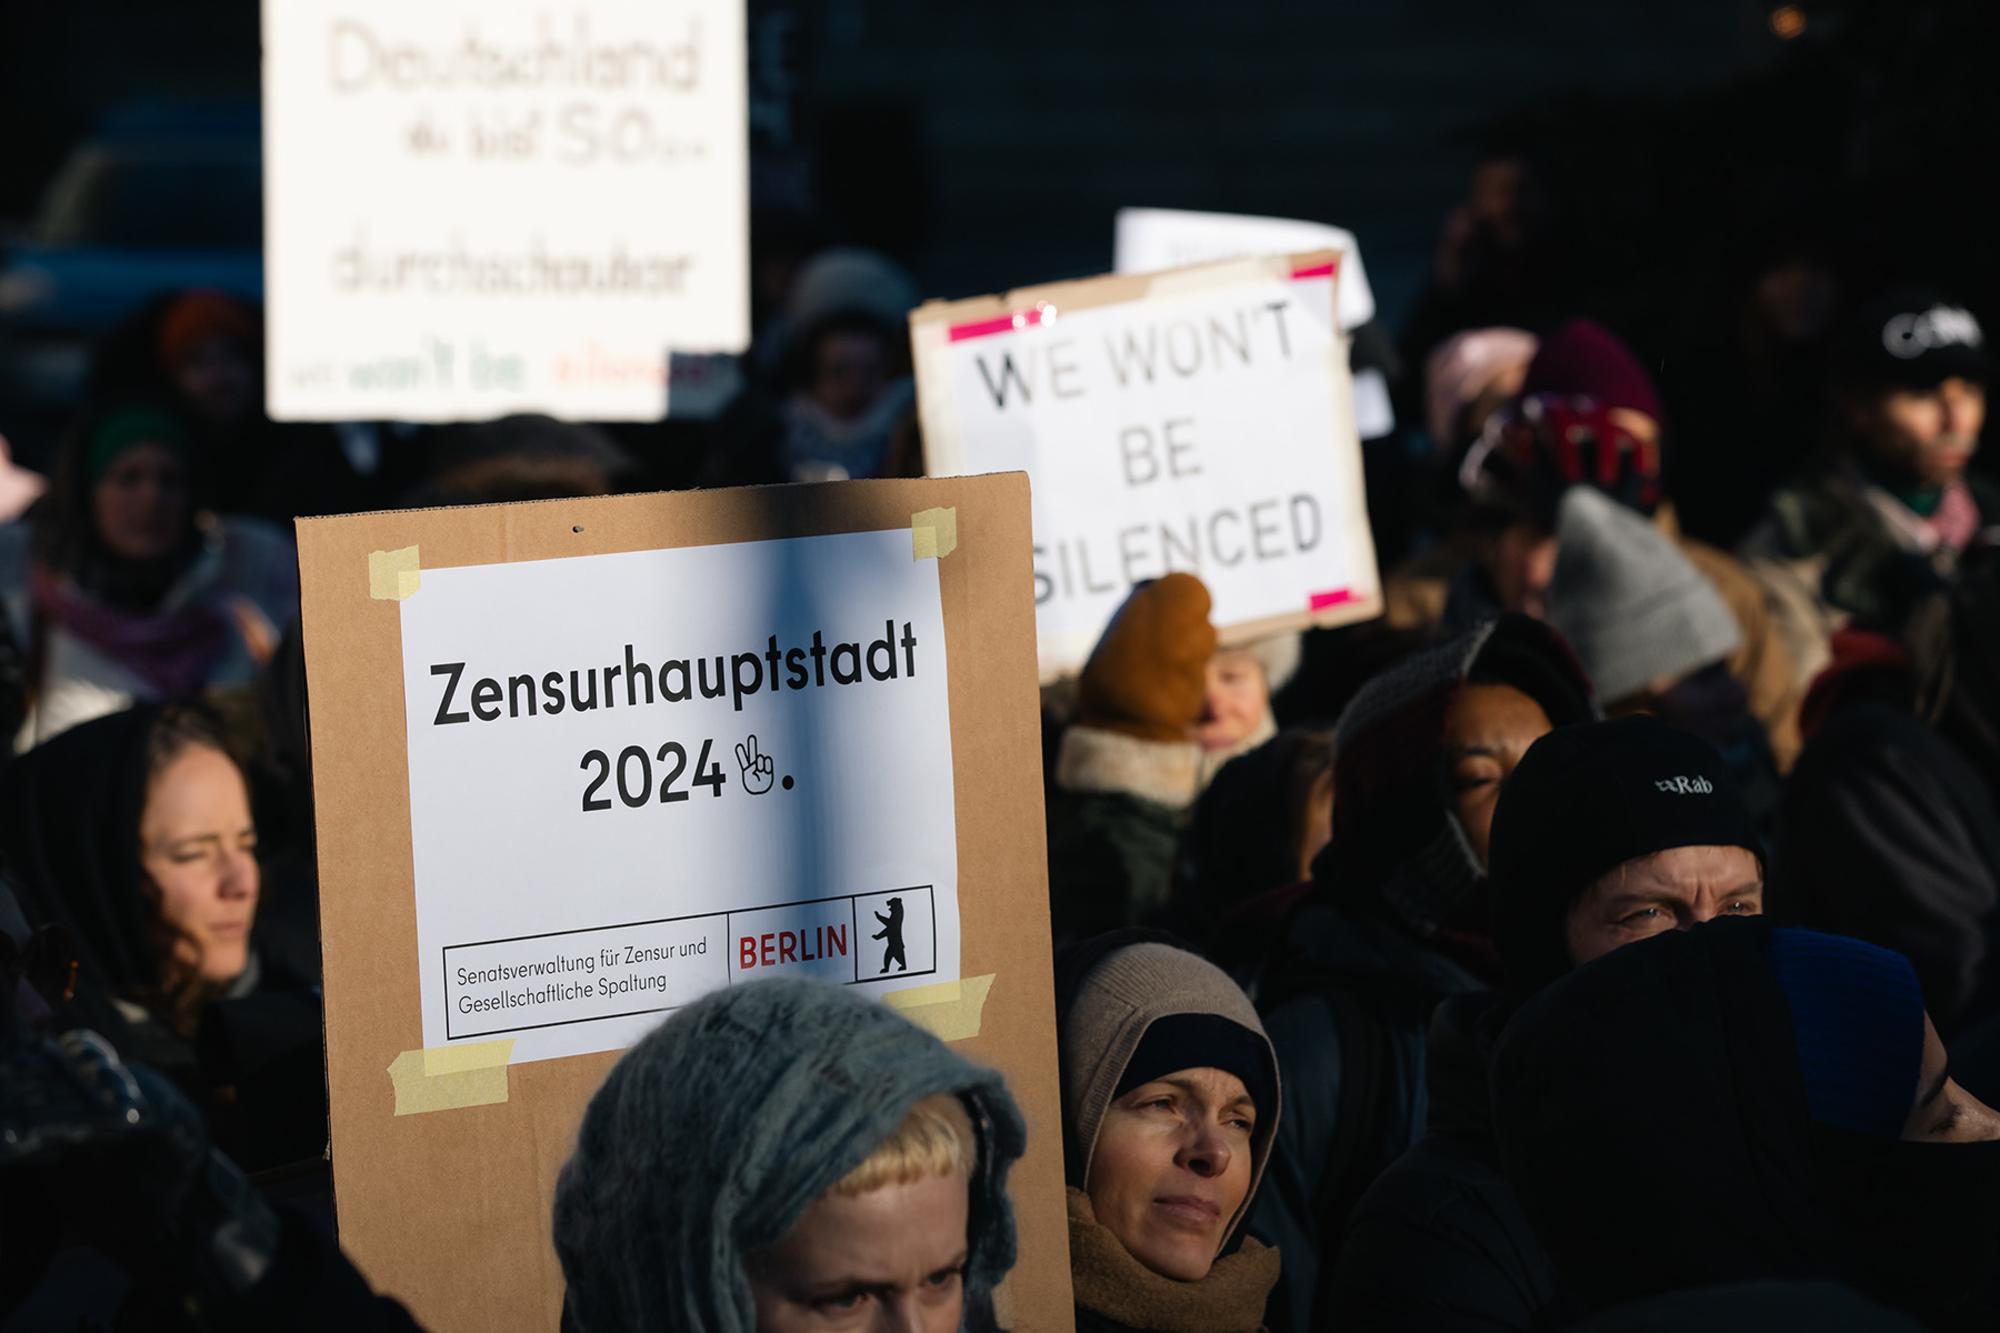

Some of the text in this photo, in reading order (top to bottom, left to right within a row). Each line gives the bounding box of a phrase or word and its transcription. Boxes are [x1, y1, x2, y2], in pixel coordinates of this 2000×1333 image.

[327, 12, 705, 96] Deutschland
[975, 301, 1293, 409] WE WON'T
[1120, 418, 1203, 487] BE
[1034, 495, 1322, 606] SILENCED
[430, 620, 917, 725] Zensurhauptstadt
[1674, 775, 1713, 794] Rab
[457, 936, 707, 986] Senatsverwaltung für Zensur und
[740, 924, 847, 969] BERLIN
[458, 973, 667, 1014] Gesellschaftliche Spaltung
